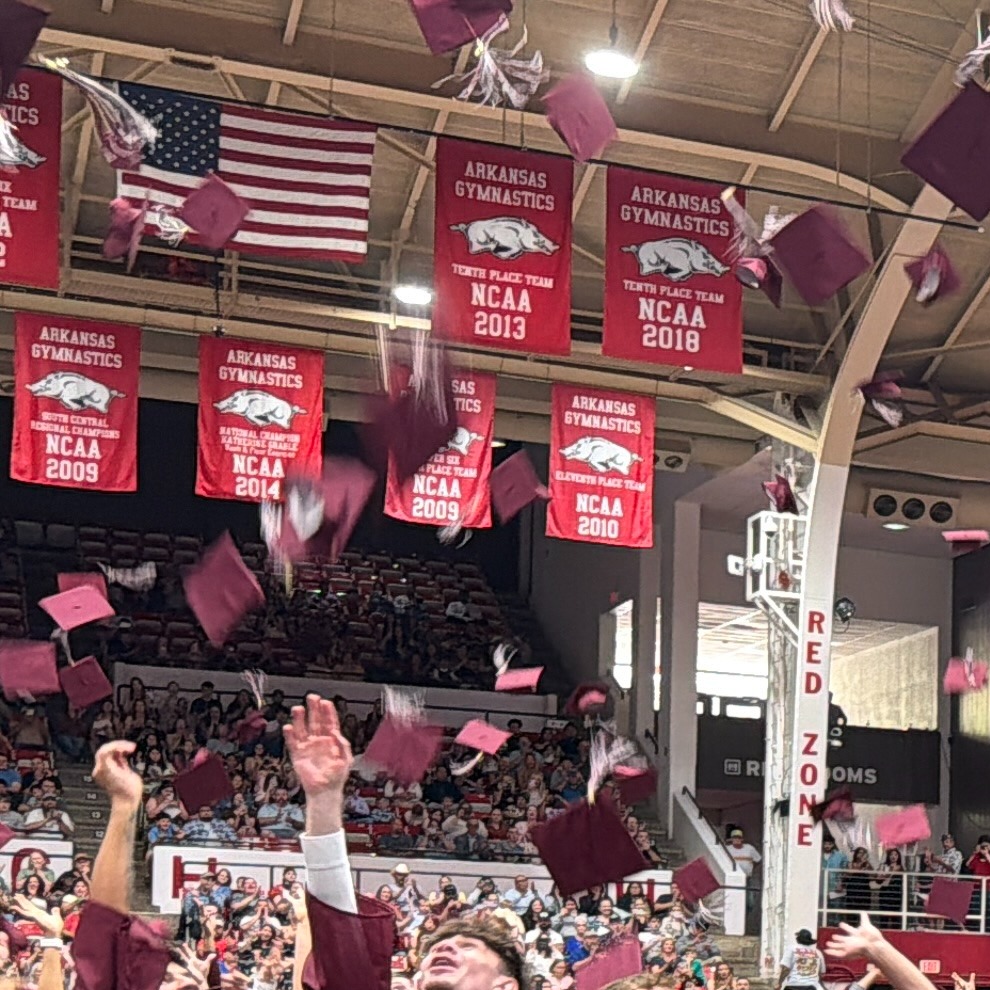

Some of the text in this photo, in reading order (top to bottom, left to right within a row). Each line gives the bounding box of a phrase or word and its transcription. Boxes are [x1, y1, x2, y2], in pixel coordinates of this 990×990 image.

[464, 160, 547, 189] ARKANSAS
[455, 180, 555, 211] GYMNASTICS
[630, 185, 721, 214] ARKANSAS
[620, 204, 730, 237] GYMNASTICS
[451, 262, 553, 289] TENTH PLACE TEAM
[471, 282, 532, 313] NCAA
[622, 279, 725, 304] TENTH PLACE TEAM
[638, 297, 706, 328] NCAA
[39, 326, 116, 349] ARKANSAS
[474, 311, 526, 340] 2013
[642, 324, 700, 353] 2018
[31, 344, 123, 369] GYMNASTICS
[226, 349, 297, 370] ARKANSAS
[218, 366, 303, 389] GYMNASTICS
[572, 395, 637, 417] ARKANSAS
[564, 411, 642, 435] GYMNASTICS
[45, 434, 102, 459] NCAA
[45, 458, 99, 483] 2009
[232, 454, 285, 479] NCAA
[426, 463, 453, 476] PLACE
[453, 466, 478, 479] TEAM
[235, 477, 281, 500] 2014
[412, 474, 461, 499] NCAA
[412, 497, 460, 521] 2009
[576, 493, 624, 517] NCAA
[578, 516, 619, 539] 2010
[797, 610, 825, 846] RED ZONE
